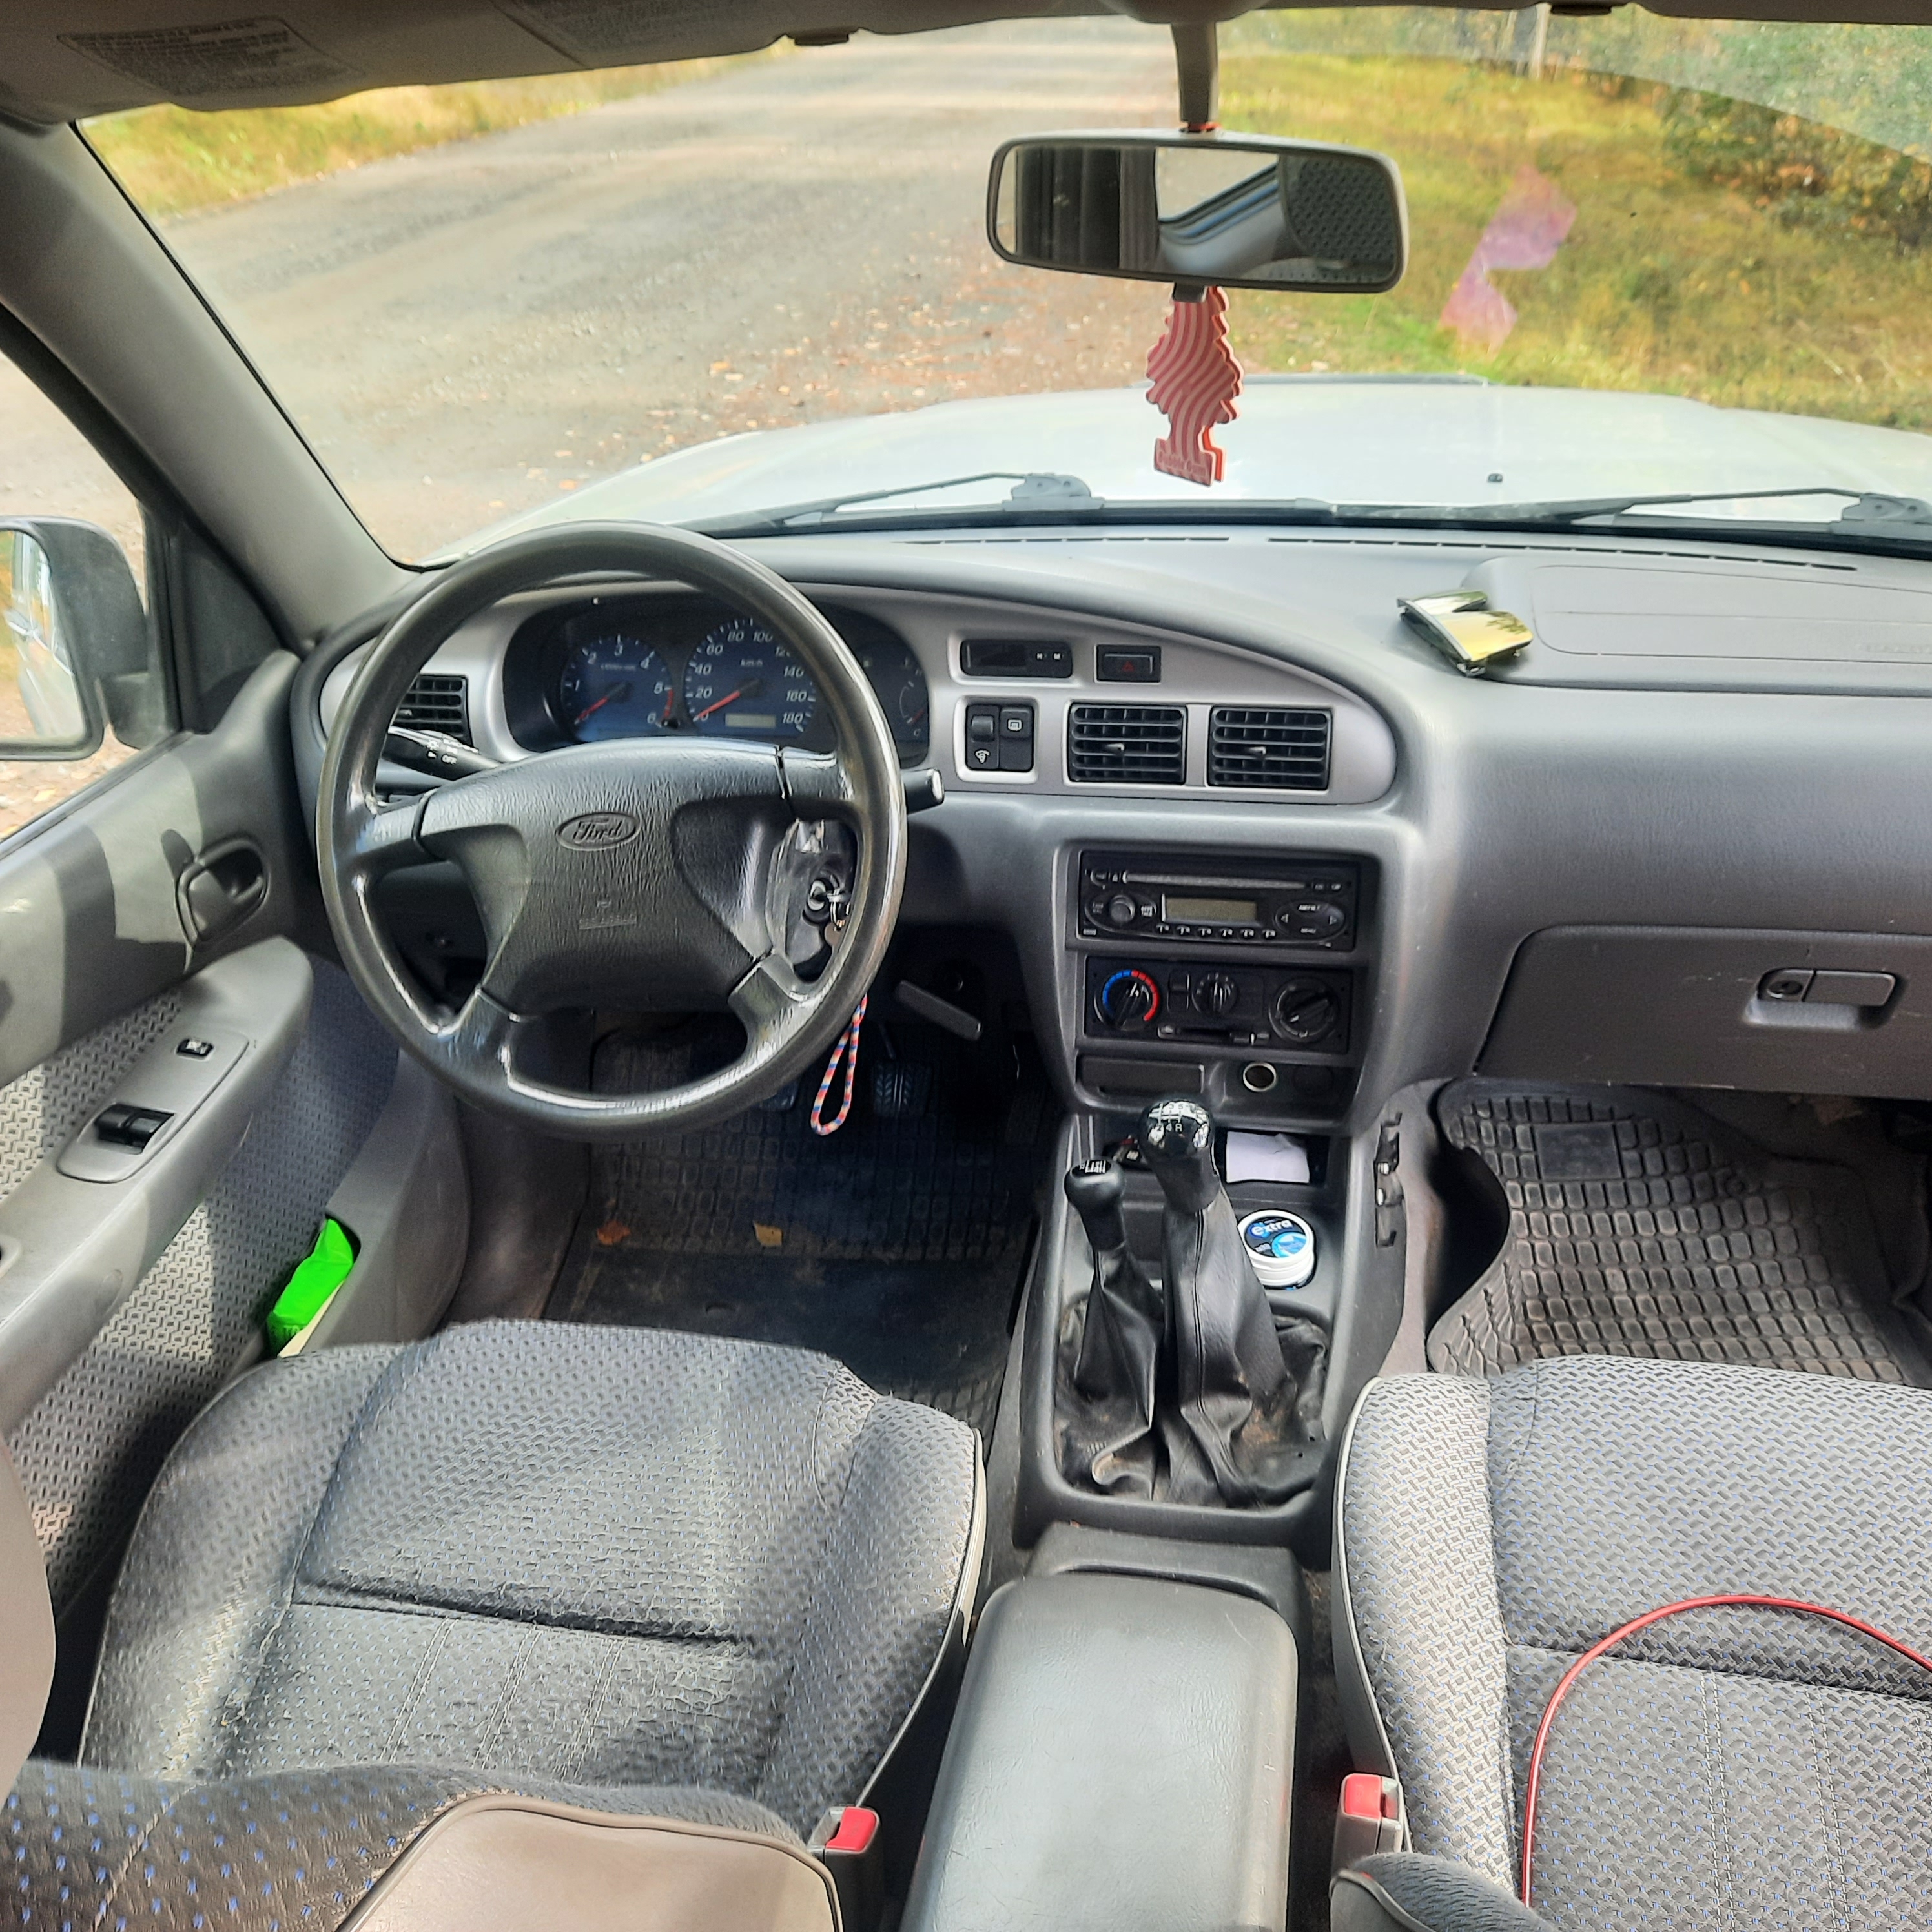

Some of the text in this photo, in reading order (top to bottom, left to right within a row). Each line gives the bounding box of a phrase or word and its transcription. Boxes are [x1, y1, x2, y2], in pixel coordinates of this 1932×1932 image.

[695, 686, 713, 699] 20
[442, 755, 458, 765] OFF
[572, 816, 626, 845] Ford
[1175, 1123, 1182, 1133] R
[1251, 1219, 1293, 1236] extra
